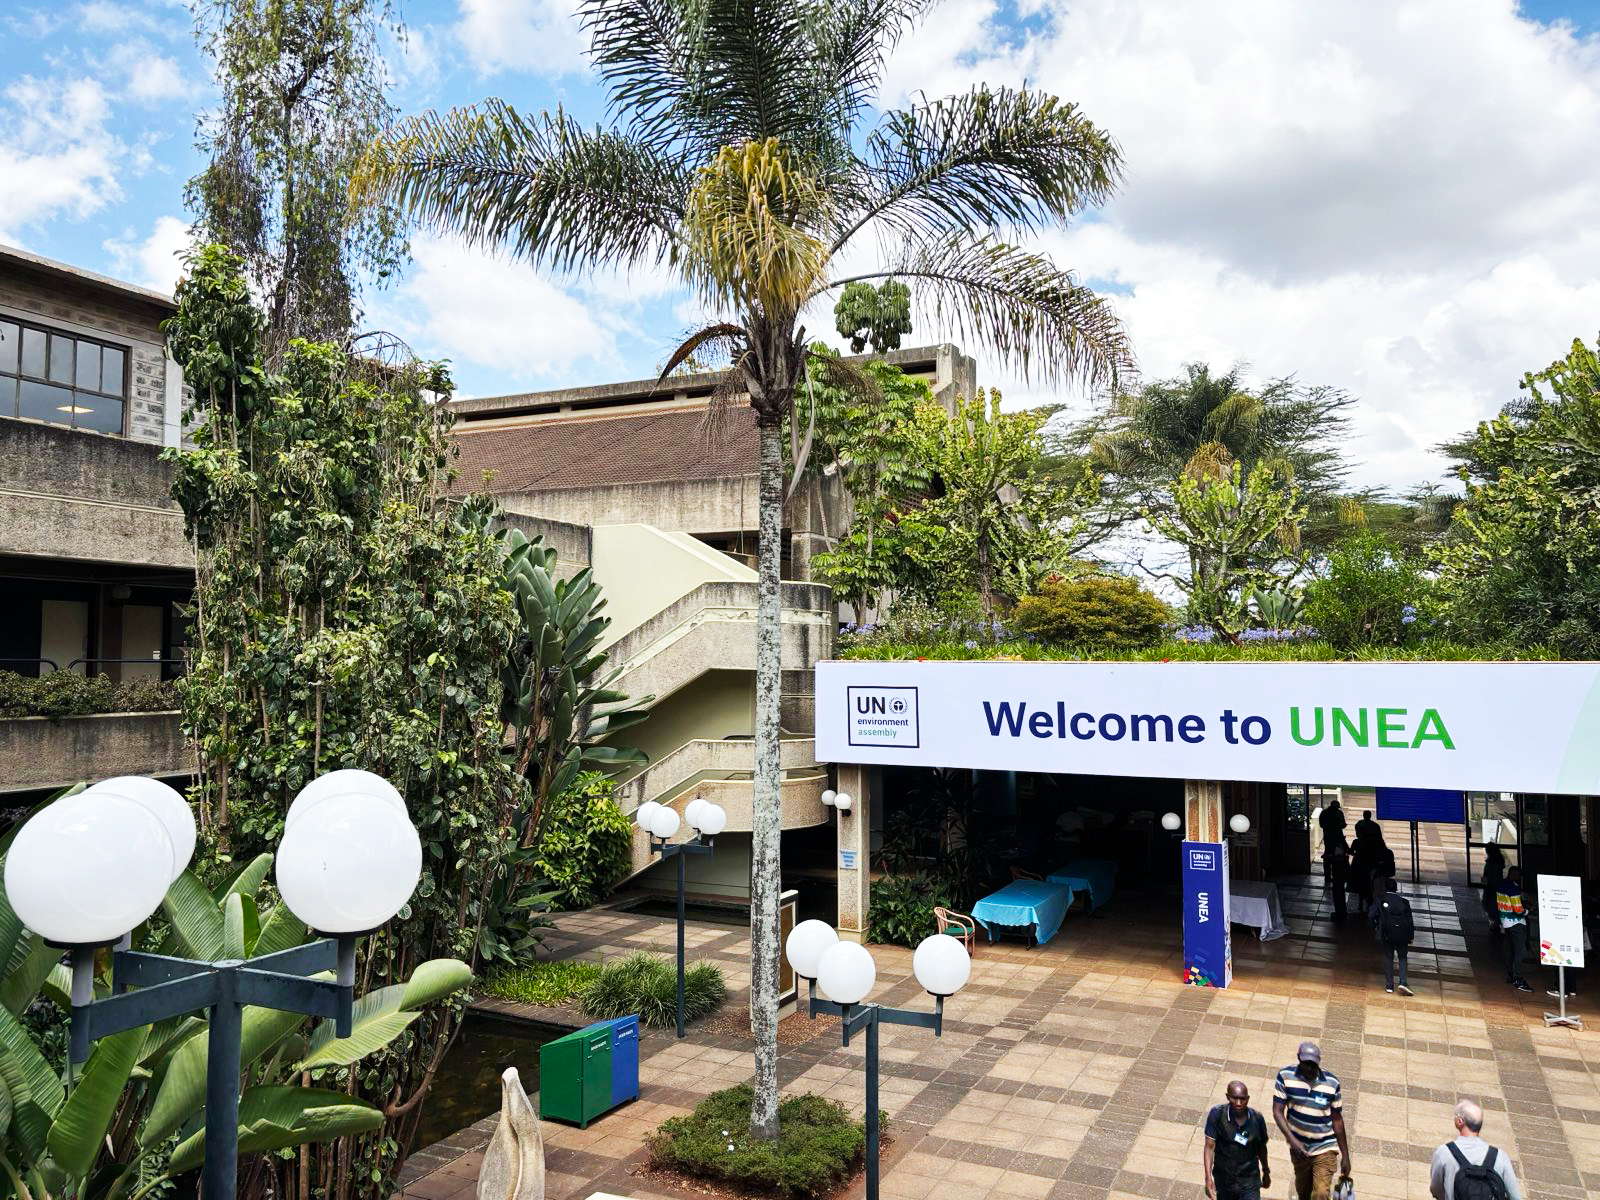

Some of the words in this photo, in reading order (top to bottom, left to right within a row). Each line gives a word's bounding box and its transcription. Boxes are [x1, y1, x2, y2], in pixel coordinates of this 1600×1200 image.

[857, 696, 886, 715] UN
[857, 717, 909, 726] environment
[982, 700, 1206, 744] Welcome
[1219, 709, 1272, 746] to
[1290, 706, 1457, 751] UNEA
[858, 728, 897, 738] assembly
[1198, 892, 1209, 923] UNEA
